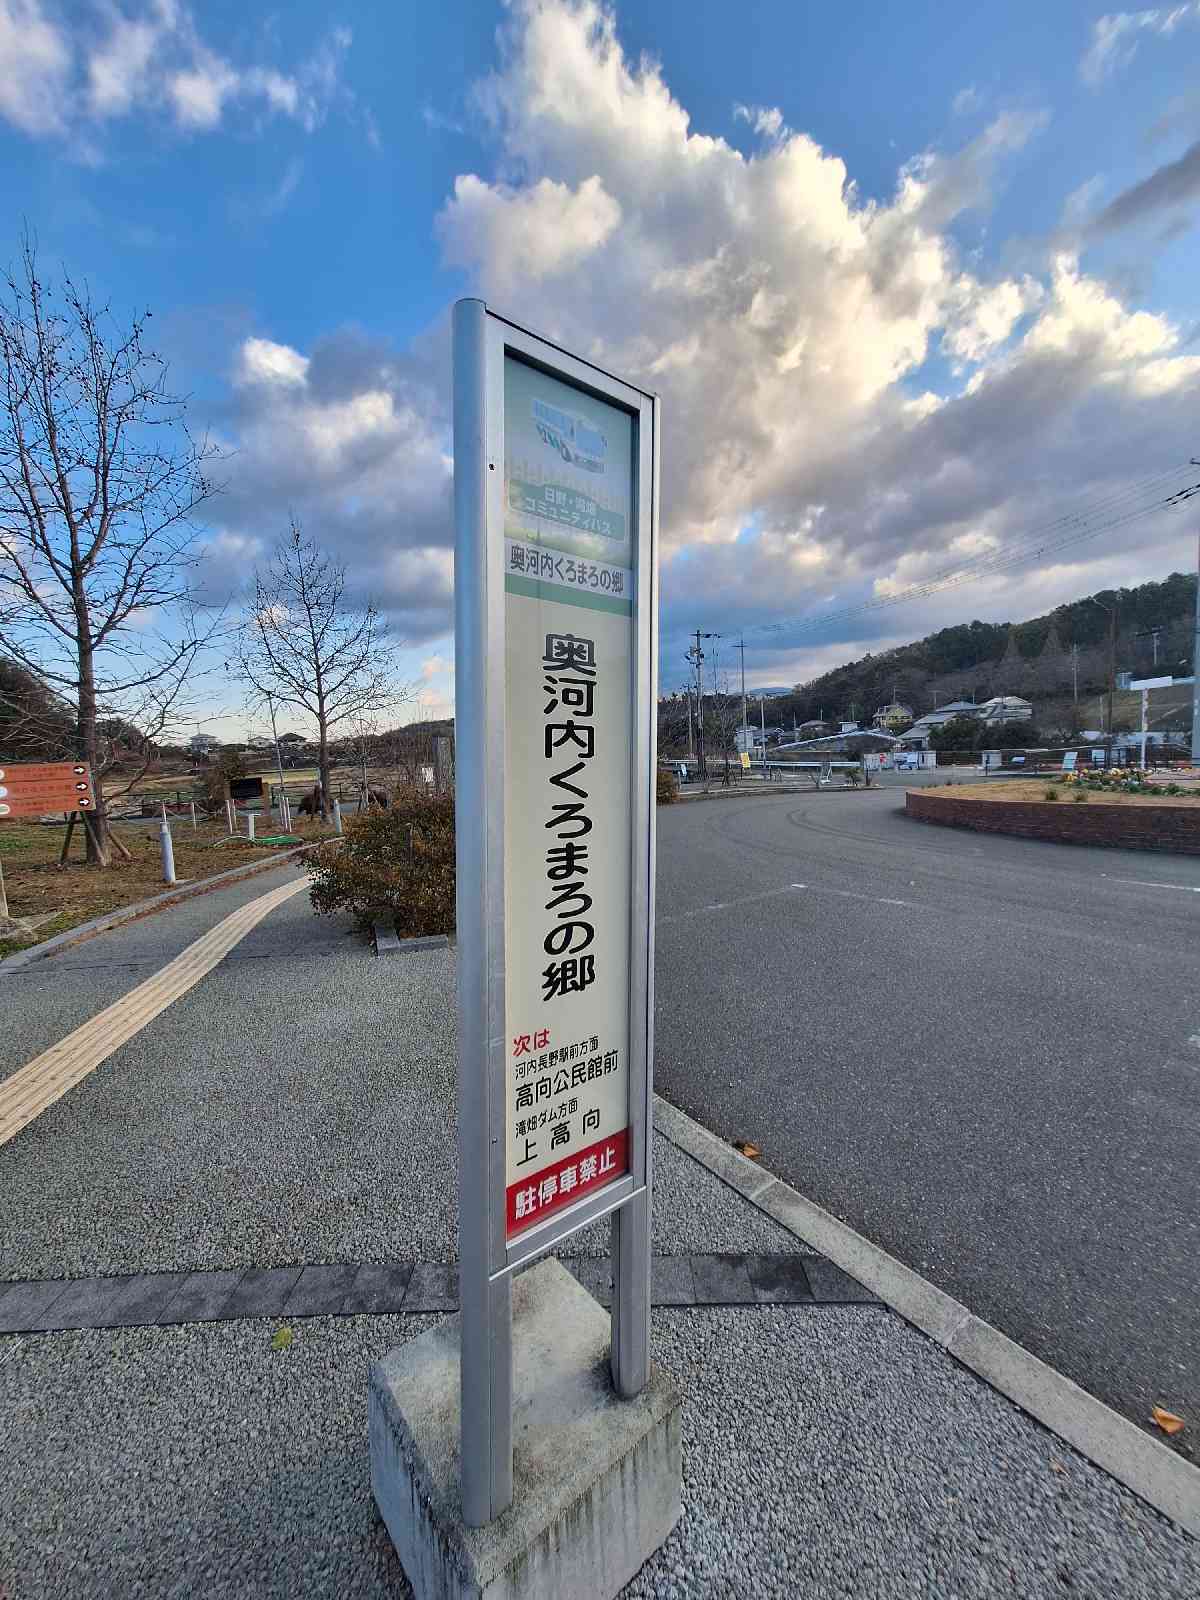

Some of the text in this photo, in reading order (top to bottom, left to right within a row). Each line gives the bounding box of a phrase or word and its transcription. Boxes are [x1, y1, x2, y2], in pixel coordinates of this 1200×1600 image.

[510, 544, 624, 593] 奥河内くろまろの郷
[541, 632, 597, 1001] 奥河内くろまろの郷
[512, 1028, 551, 1057] 次は
[515, 1036, 599, 1080] 河内長野駅前方面
[515, 1049, 619, 1112] 高向公民館前
[515, 1097, 578, 1139] 滝畑ダム方面
[515, 1147, 616, 1220] 駐停車禁止
